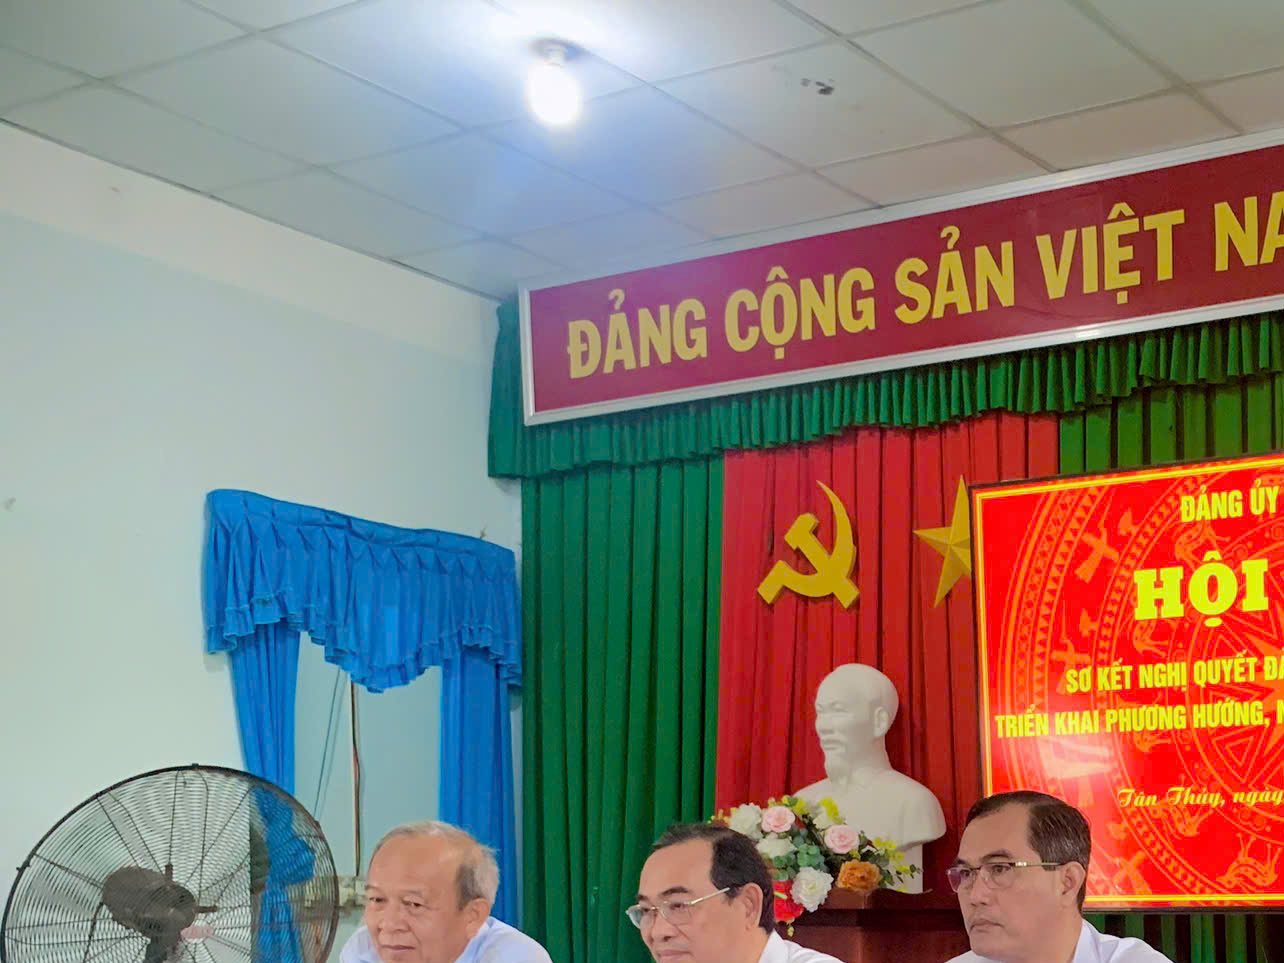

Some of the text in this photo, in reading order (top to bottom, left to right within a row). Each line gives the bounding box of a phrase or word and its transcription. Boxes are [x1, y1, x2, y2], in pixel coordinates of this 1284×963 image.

[566, 289, 707, 379] ĐẢNG
[724, 266, 875, 362] CỘNG
[894, 226, 1014, 325] SẢN
[1037, 202, 1185, 305] VIỆT
[1180, 485, 1243, 523] ĐẢNG
[1249, 478, 1281, 516] ỦY
[1134, 550, 1269, 627] HỘI
[1097, 658, 1134, 692] KẾT
[1138, 661, 1188, 692] NGHỊ
[1193, 649, 1258, 687] QUYẾT
[995, 704, 1049, 738] TRIỂN
[1054, 711, 1100, 736] KHAI
[1105, 704, 1187, 733] PHƯƠNG
[1192, 696, 1271, 730] HƯỚNG,
[1232, 786, 1284, 808] ngày
